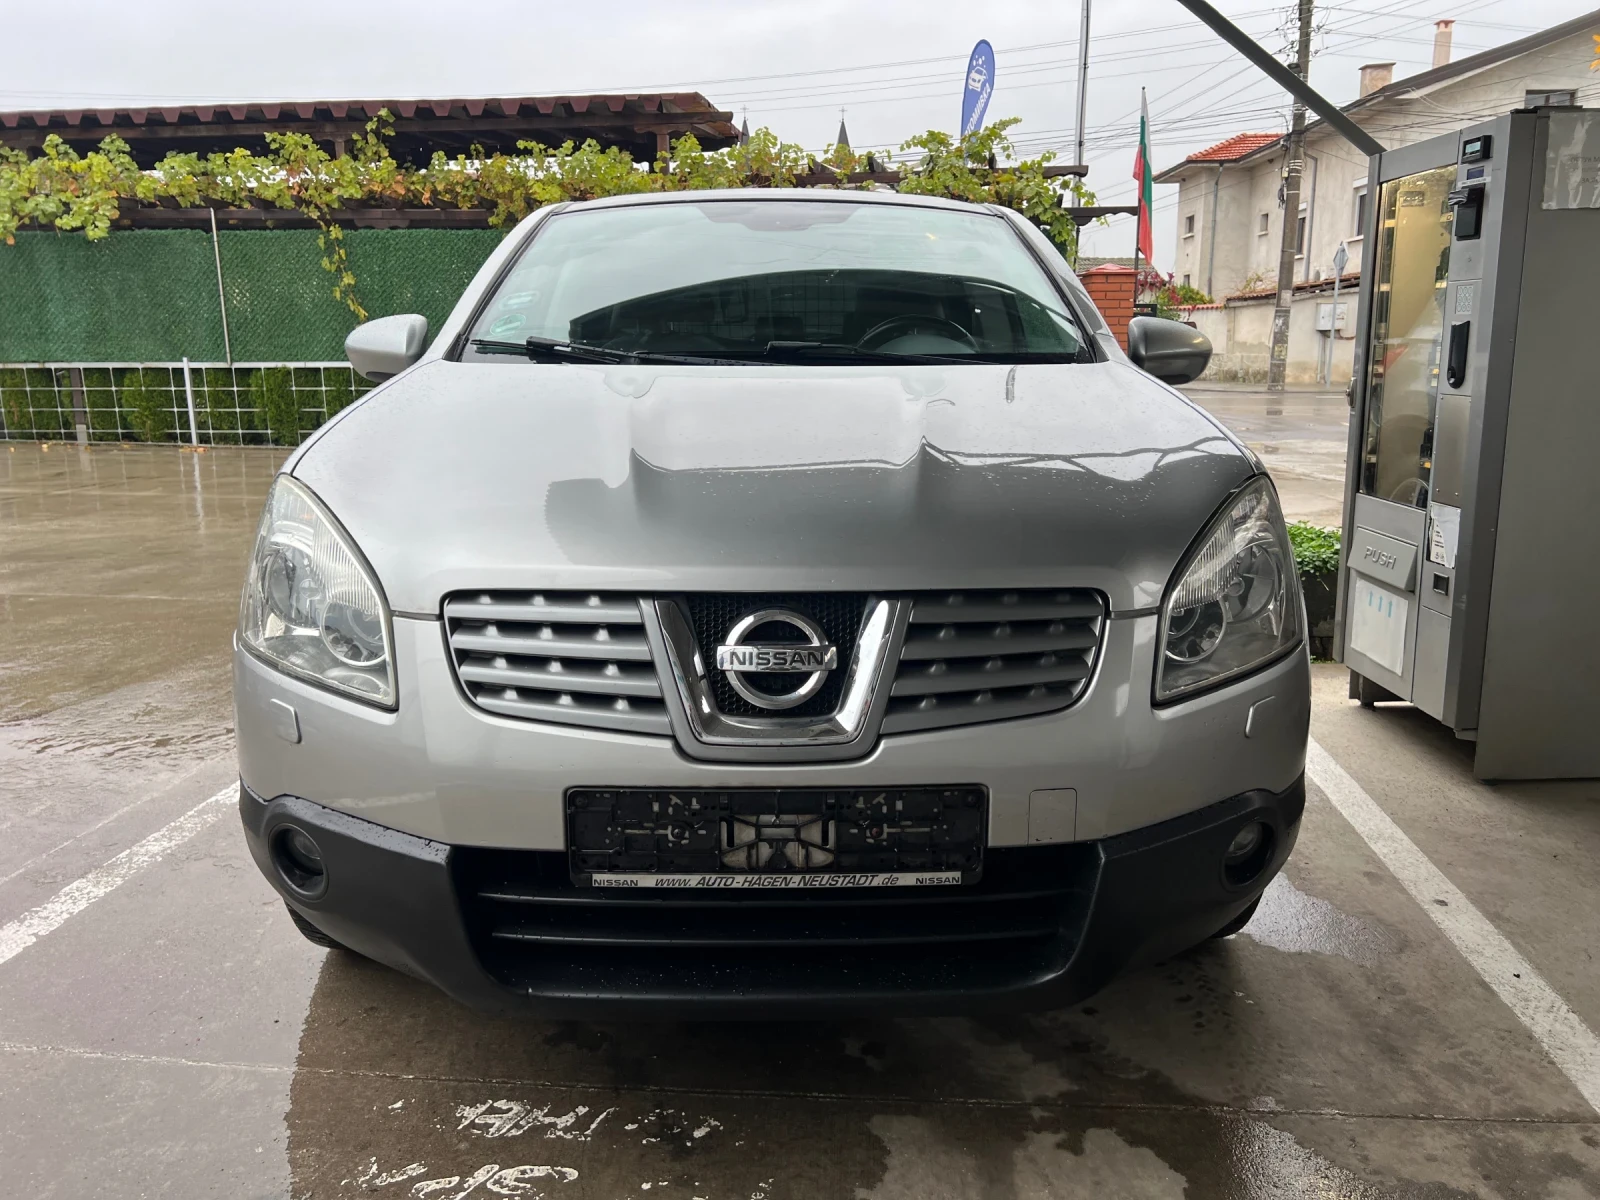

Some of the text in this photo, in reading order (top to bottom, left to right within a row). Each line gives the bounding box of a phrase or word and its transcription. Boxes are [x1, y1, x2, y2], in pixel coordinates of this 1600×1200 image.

[1364, 545, 1397, 570] PUSH
[729, 651, 825, 667] NISSAN
[593, 879, 639, 887] NISSAN
[915, 876, 961, 885] NISSAN
